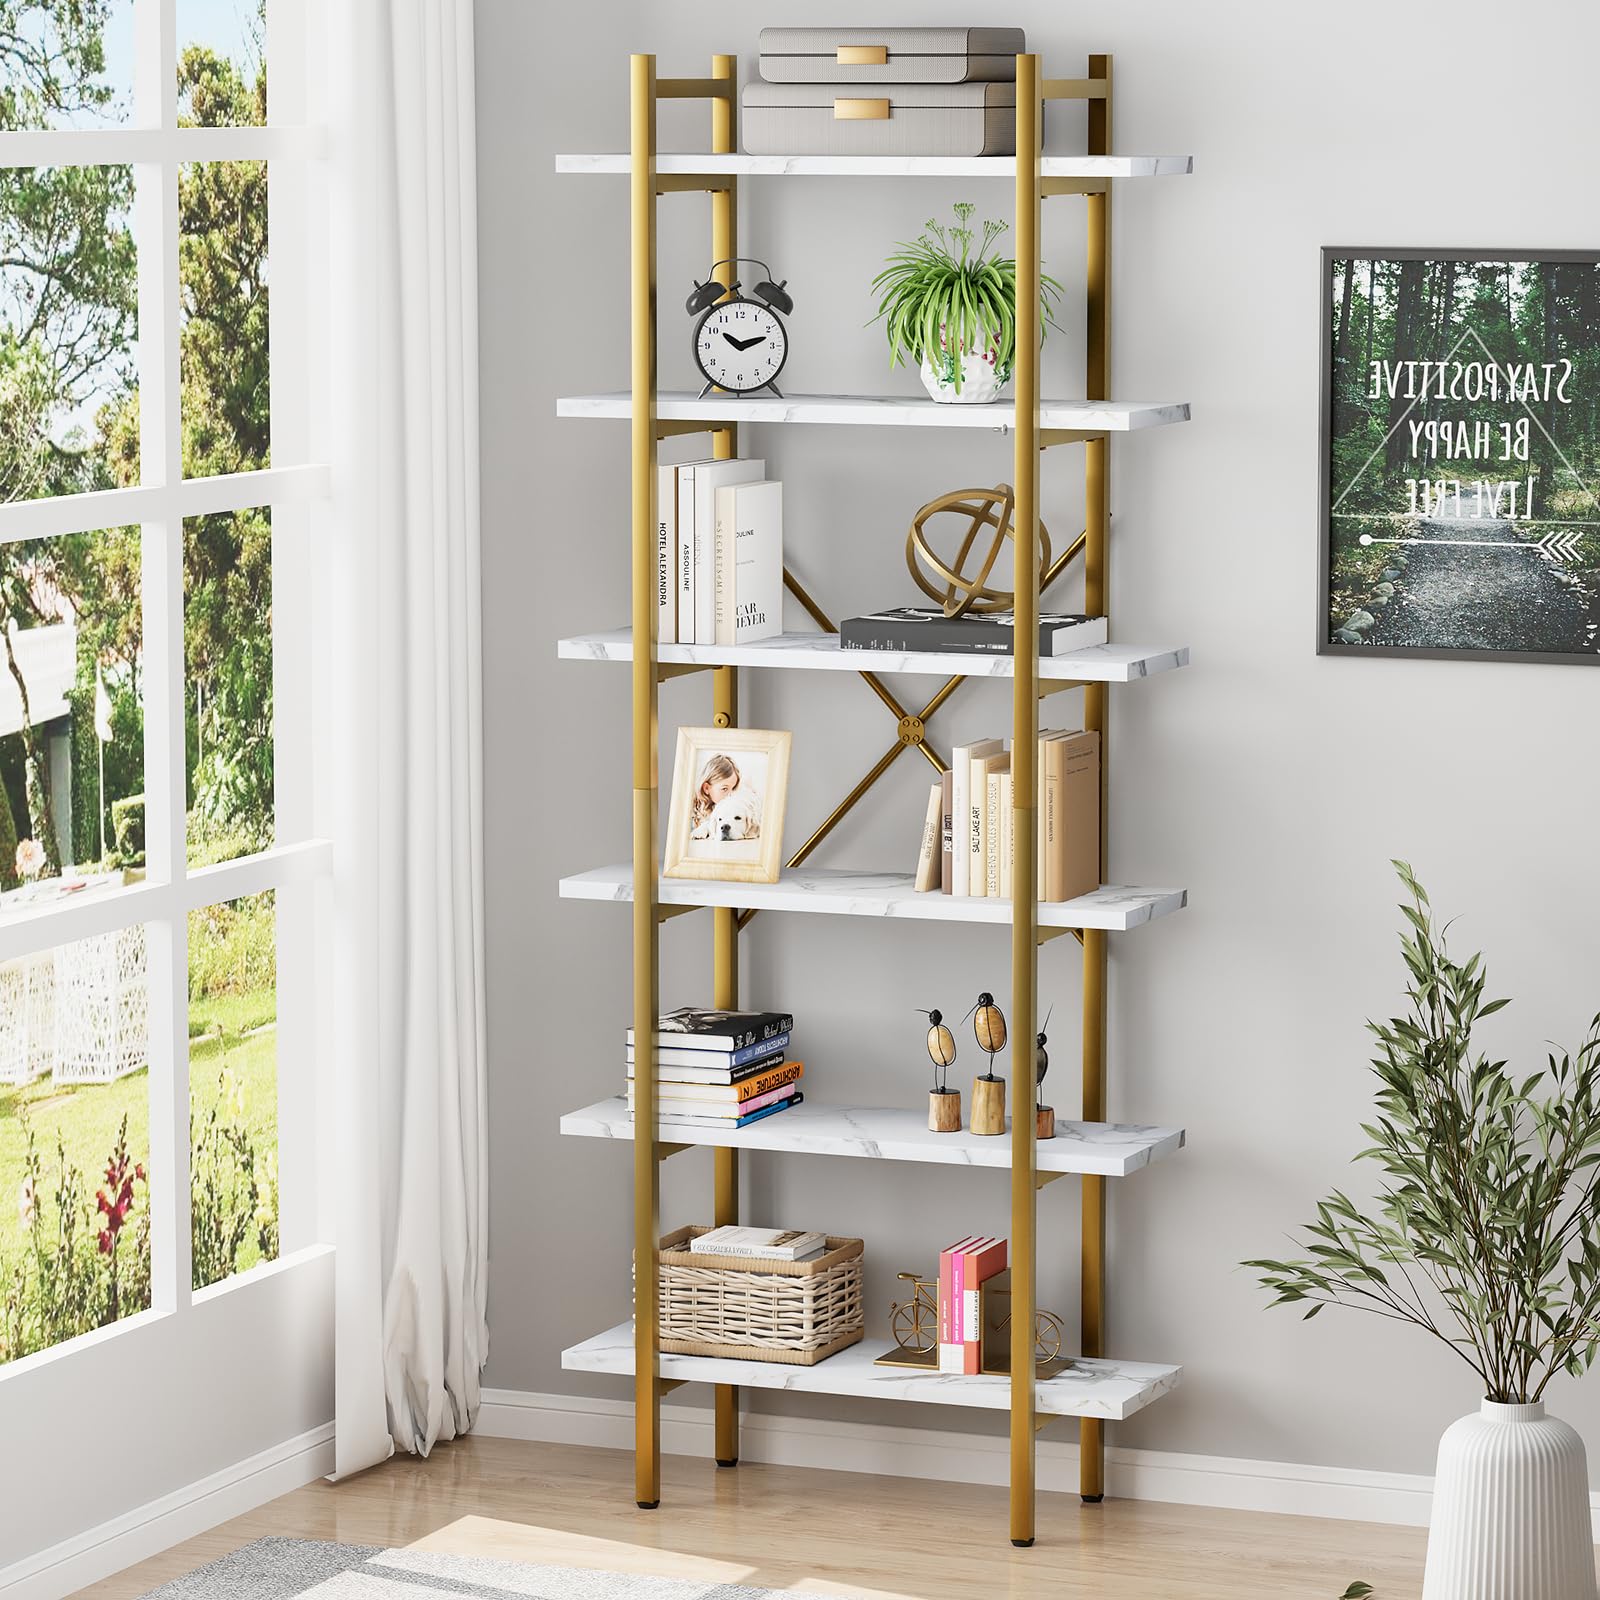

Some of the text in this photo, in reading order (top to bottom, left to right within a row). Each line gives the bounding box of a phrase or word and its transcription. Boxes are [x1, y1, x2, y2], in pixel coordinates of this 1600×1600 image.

[719, 315, 728, 323] 11
[735, 311, 745, 319] 12
[754, 314, 758, 322] 1
[708, 327, 719, 335] 10
[765, 325, 771, 333] 2
[704, 342, 711, 350] 9
[769, 342, 775, 350] 3
[710, 358, 716, 366] 8
[766, 357, 771, 365] 4
[659, 522, 667, 607] HOTEL ALEXANDRA
[972, 806, 980, 853] SALT LAKE ART
[756, 1065, 801, 1094] ARCHITECTURE
